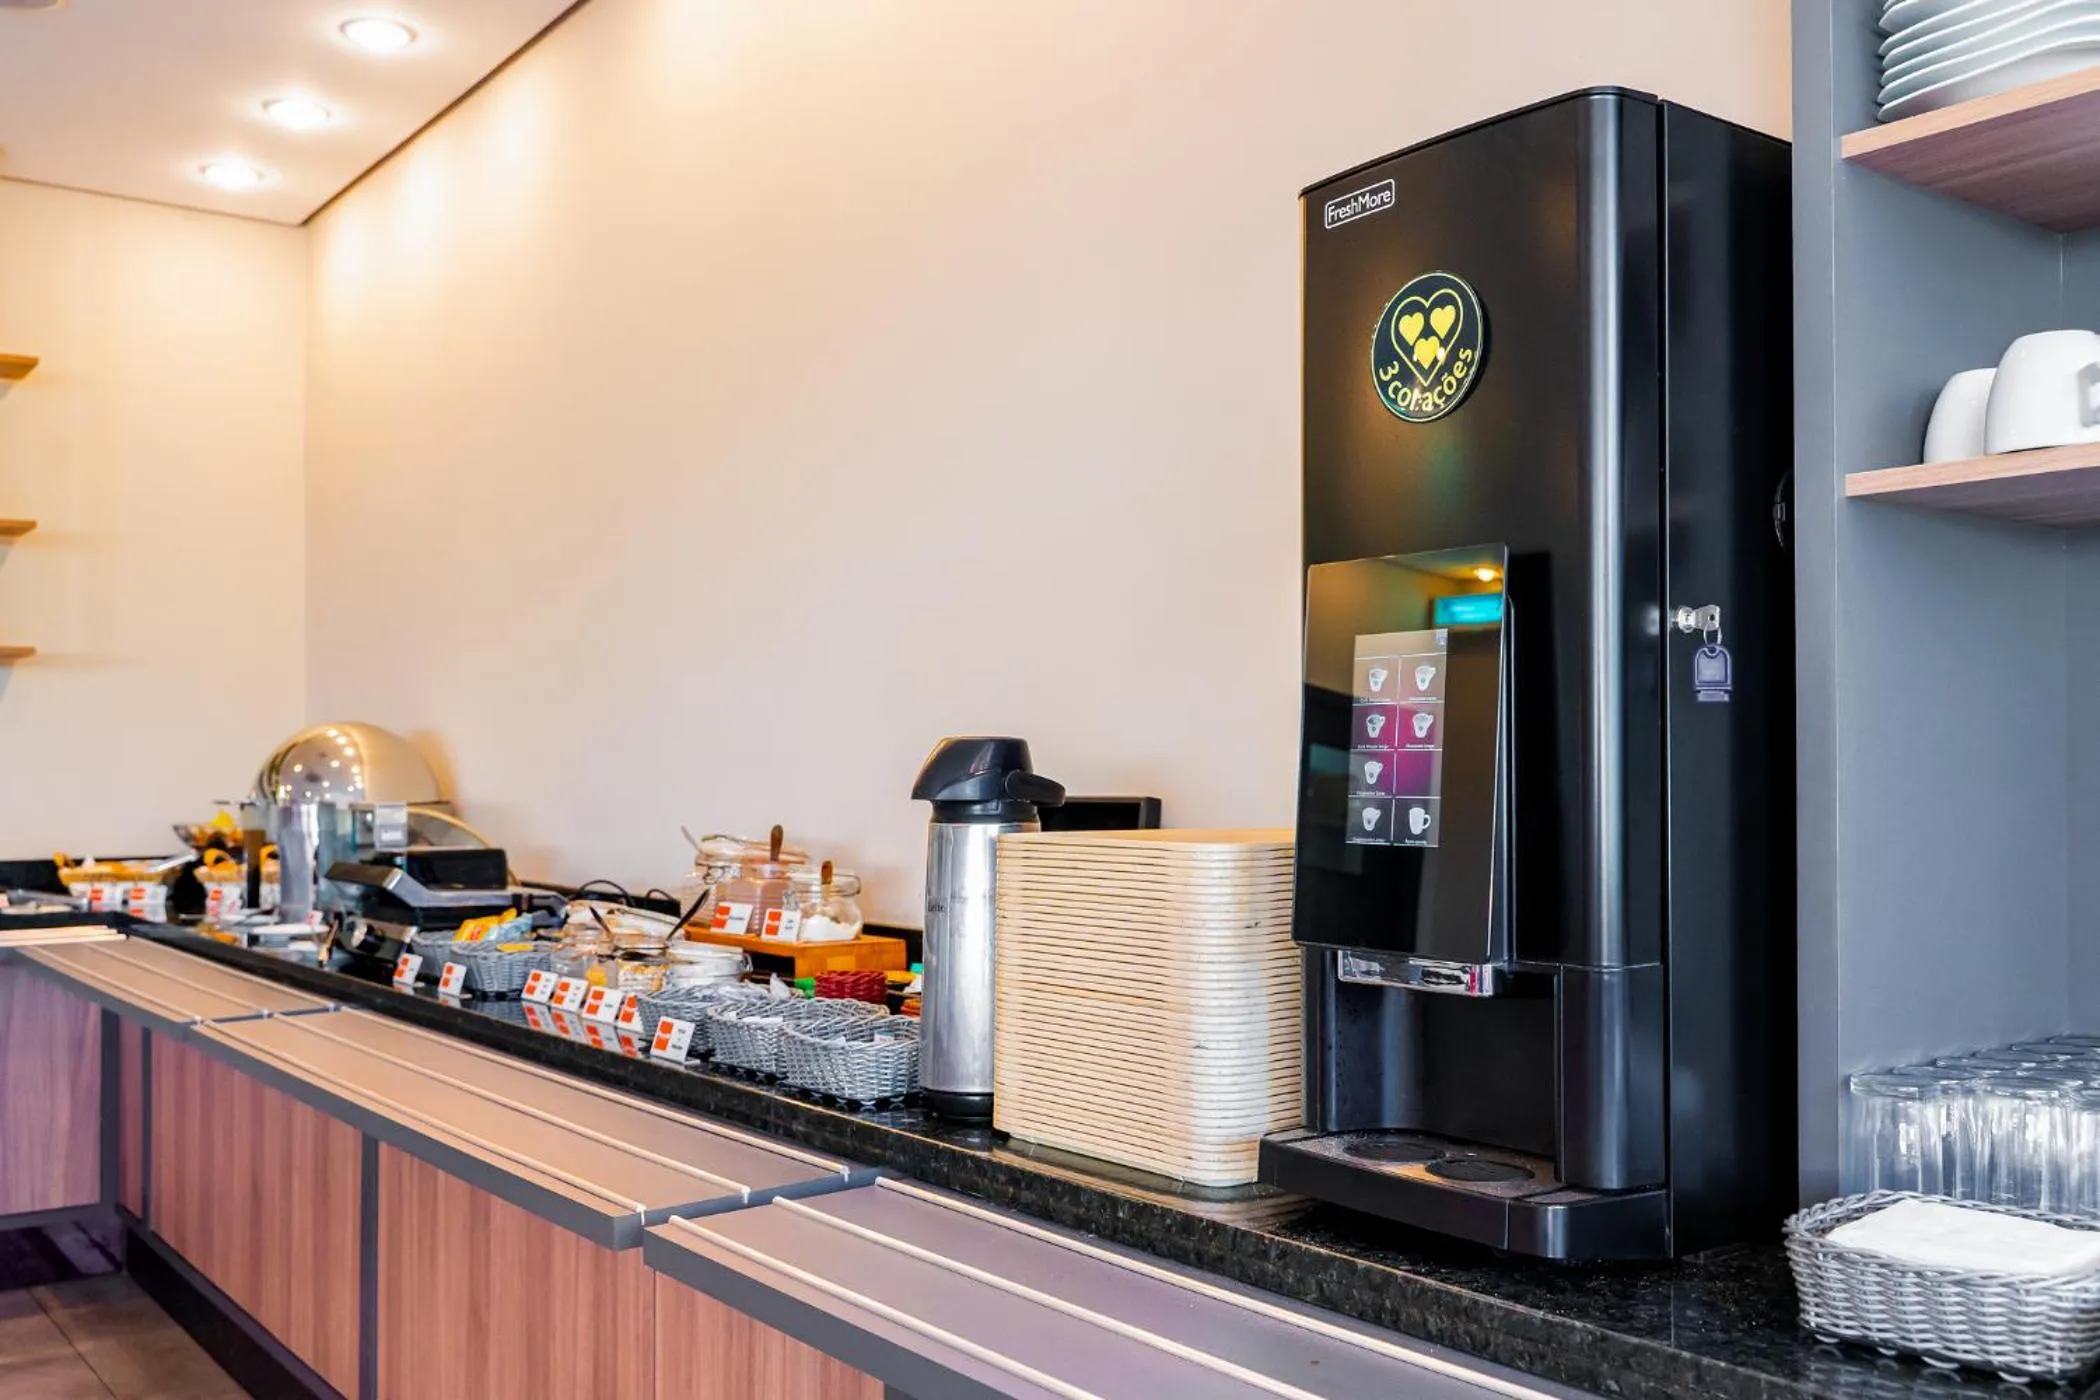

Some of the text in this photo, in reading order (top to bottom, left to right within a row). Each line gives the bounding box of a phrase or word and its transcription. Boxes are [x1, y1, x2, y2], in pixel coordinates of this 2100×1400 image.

[1328, 189, 1391, 223] FreshMore
[1379, 347, 1473, 412] 3 corações
